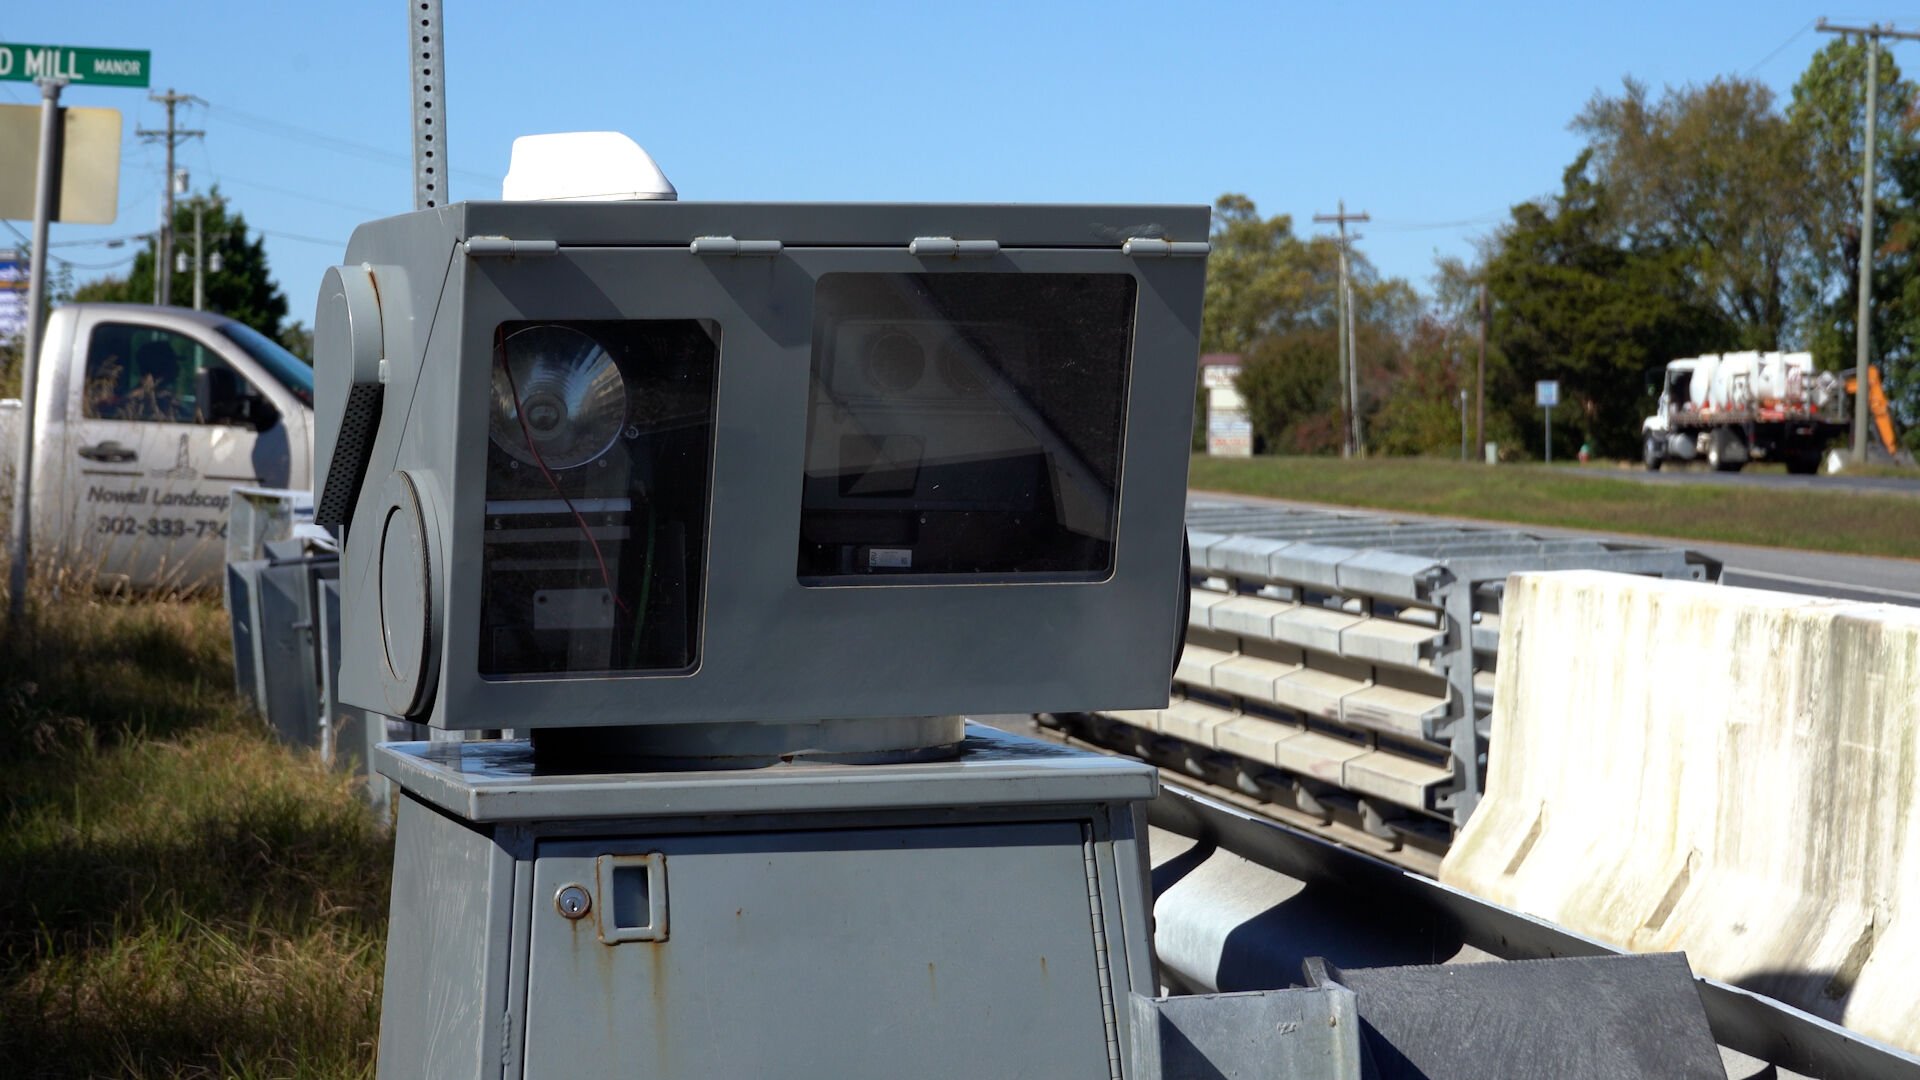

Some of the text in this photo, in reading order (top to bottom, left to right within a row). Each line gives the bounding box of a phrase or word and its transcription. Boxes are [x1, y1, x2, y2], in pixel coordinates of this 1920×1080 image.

[24, 48, 84, 79] MILL
[93, 58, 141, 76] MANOR
[88, 486, 149, 504] Nowell
